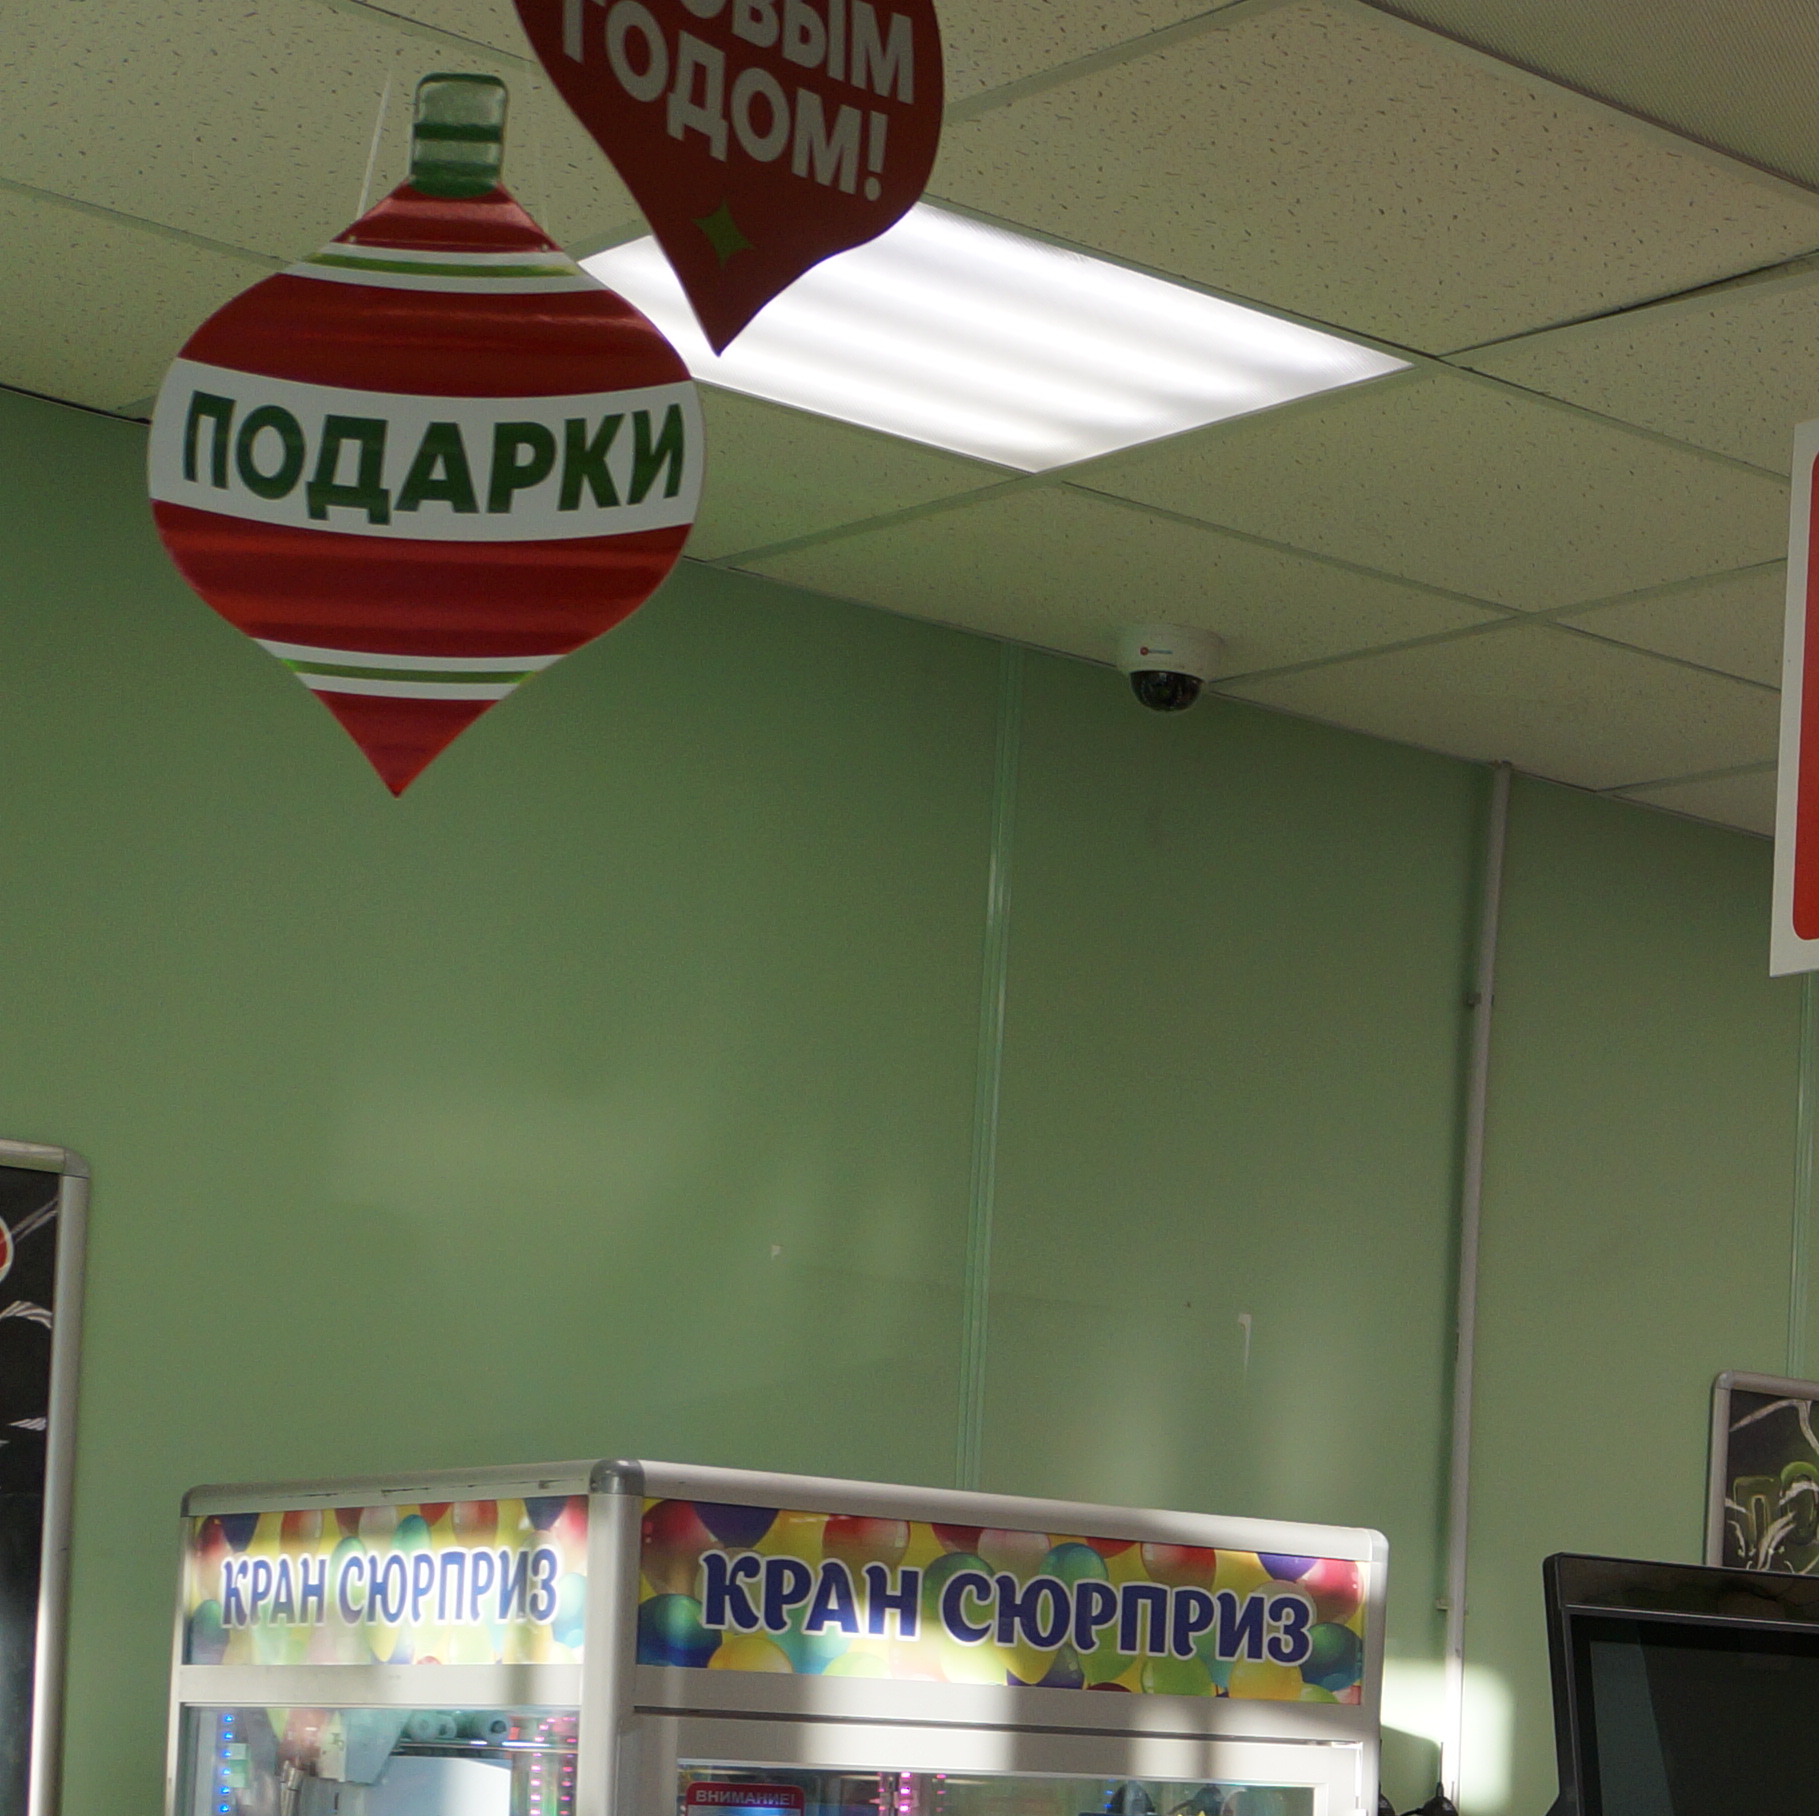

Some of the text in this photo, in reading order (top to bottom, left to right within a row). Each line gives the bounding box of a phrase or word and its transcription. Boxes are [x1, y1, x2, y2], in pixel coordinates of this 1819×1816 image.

[562, 0, 889, 200] ГОДОМ!
[681, 0, 914, 104] ВЫМ
[183, 390, 685, 525] ПОДАРКИ
[222, 1547, 559, 1628] КРАН СЮРПРИЗ
[702, 1552, 1316, 1664] КРАН СЮРПРИЗ
[696, 1789, 795, 1806] ВНИМАНИЕ!
